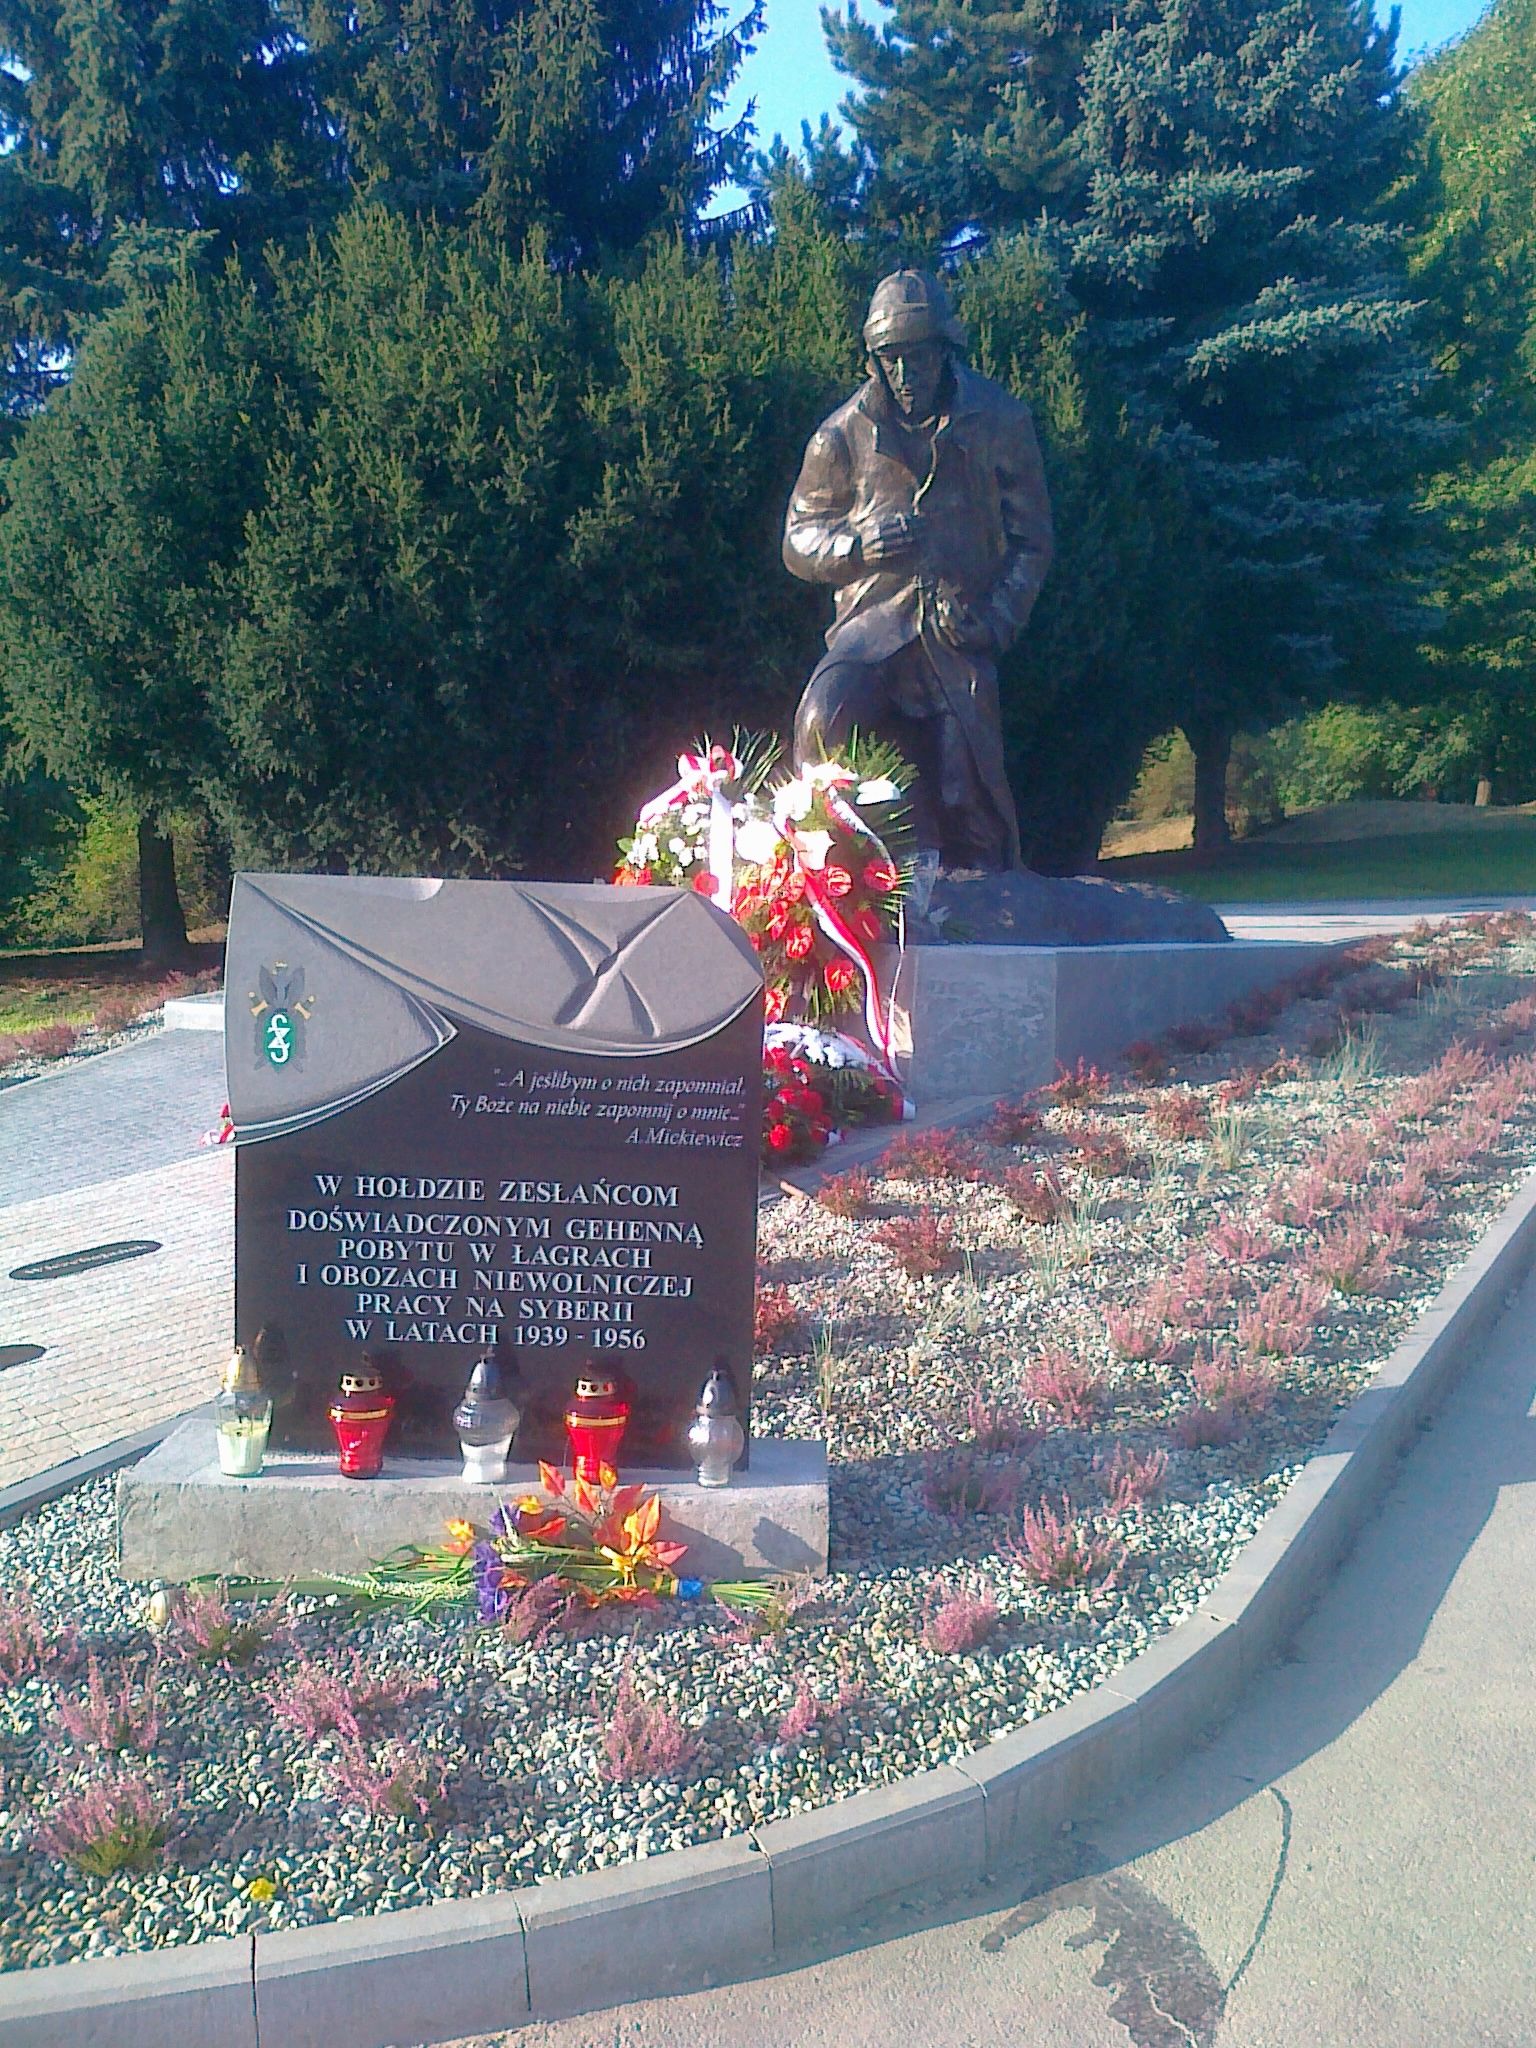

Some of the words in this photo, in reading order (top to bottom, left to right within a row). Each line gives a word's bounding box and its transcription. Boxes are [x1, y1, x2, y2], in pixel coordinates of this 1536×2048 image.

[601, 1078, 612, 1091] o
[616, 1073, 650, 1092] nich
[451, 1094, 471, 1119] Ty
[518, 1101, 540, 1115] na
[545, 1097, 591, 1116] niebie
[596, 1103, 674, 1124] zapomnij
[677, 1108, 687, 1120] o
[315, 1174, 343, 1197] W
[355, 1176, 485, 1201] HOŁDZIE
[499, 1177, 680, 1207] ZESŁAŃCOM
[288, 1204, 551, 1238] DOŚWIADCZONYM
[566, 1218, 704, 1250] GEHENNĄ
[338, 1238, 455, 1262] POBYTU
[468, 1242, 496, 1264] W
[512, 1245, 653, 1269] ŁAGRACH
[297, 1263, 308, 1285] I
[320, 1264, 458, 1289] OBOZACH
[474, 1269, 694, 1297] NIEWOLNICZEJ
[356, 1292, 453, 1316] PRACY
[465, 1296, 504, 1318] NA
[519, 1298, 634, 1322] SYBERII
[345, 1319, 375, 1341] W
[385, 1321, 499, 1344] LATACH
[514, 1325, 568, 1346] 1939
[592, 1327, 646, 1349] 1956
